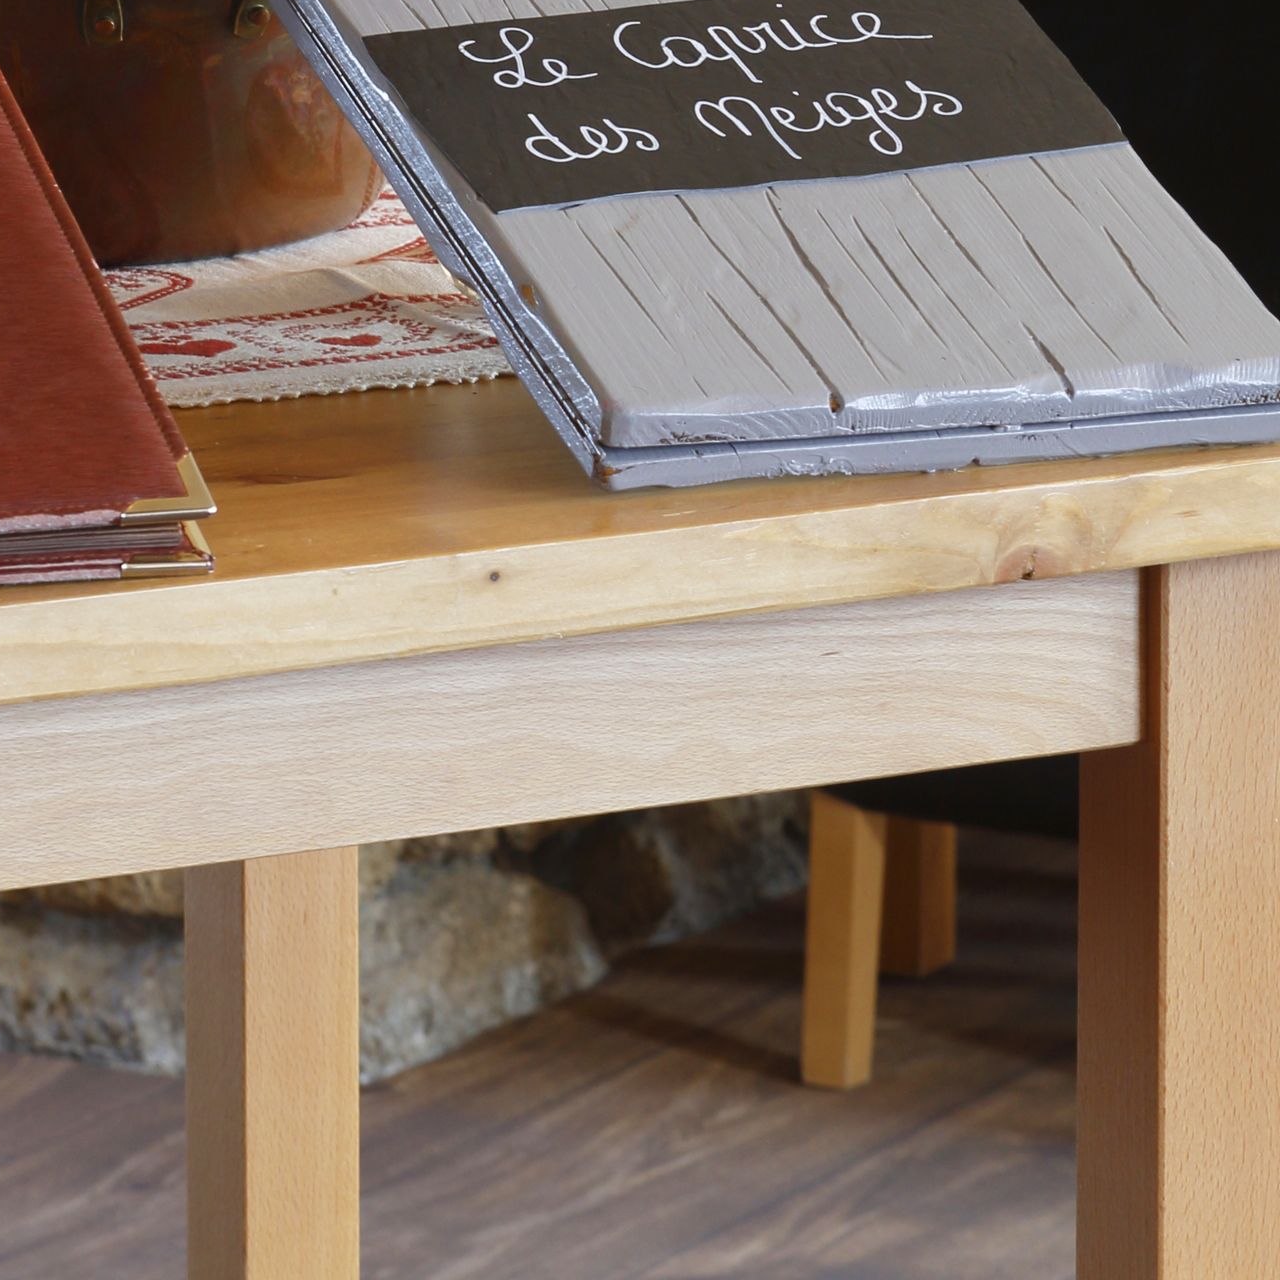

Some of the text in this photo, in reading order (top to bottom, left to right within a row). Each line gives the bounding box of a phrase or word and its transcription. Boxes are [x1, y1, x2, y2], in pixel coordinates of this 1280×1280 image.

[458, 3, 934, 89] Le Caprice
[524, 112, 661, 163] des
